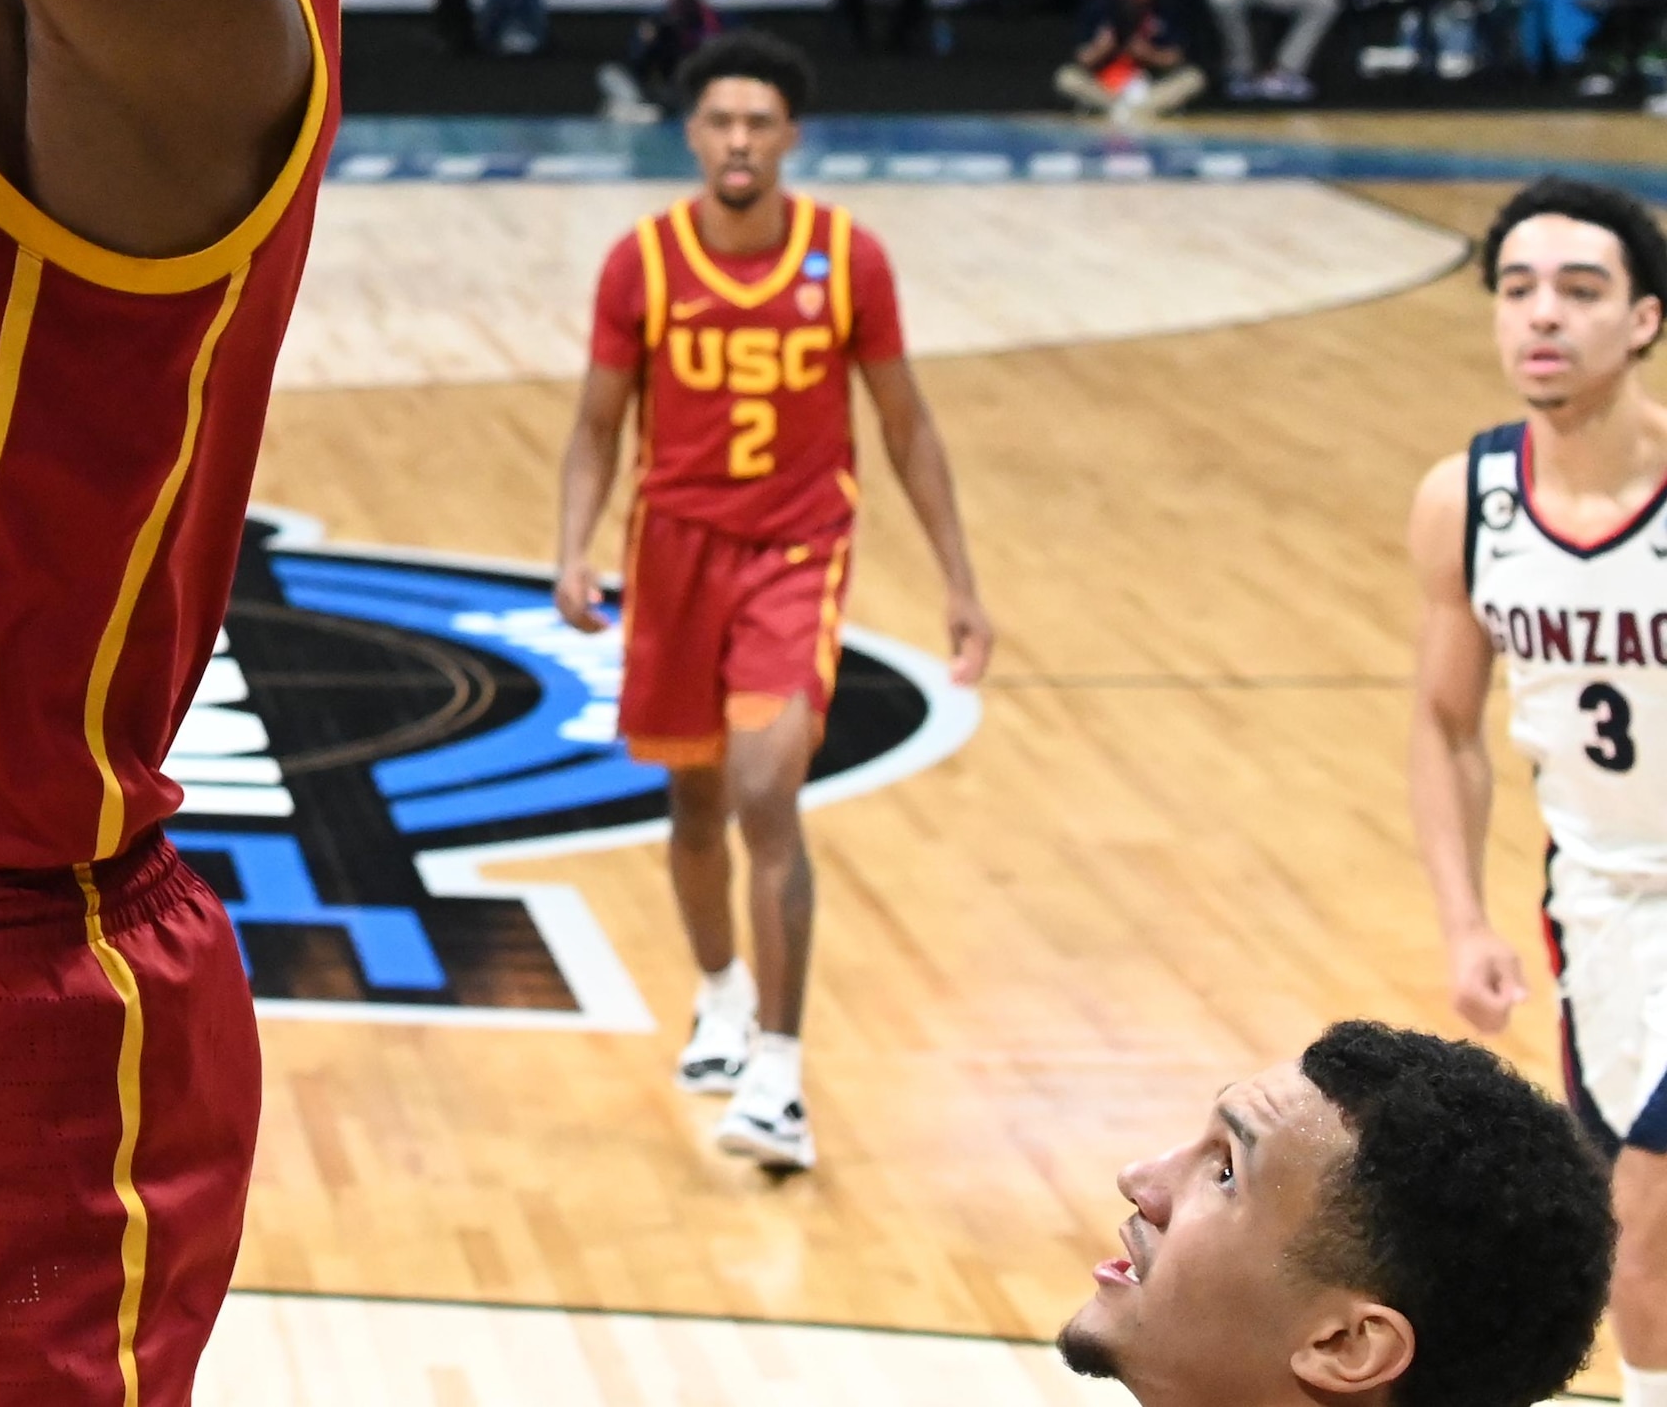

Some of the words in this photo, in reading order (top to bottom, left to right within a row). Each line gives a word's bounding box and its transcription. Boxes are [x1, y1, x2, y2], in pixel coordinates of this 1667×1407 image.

[668, 326, 833, 393] USC
[728, 398, 777, 479] 2
[1484, 601, 1667, 667] ONZA
[1578, 681, 1636, 773] 3
